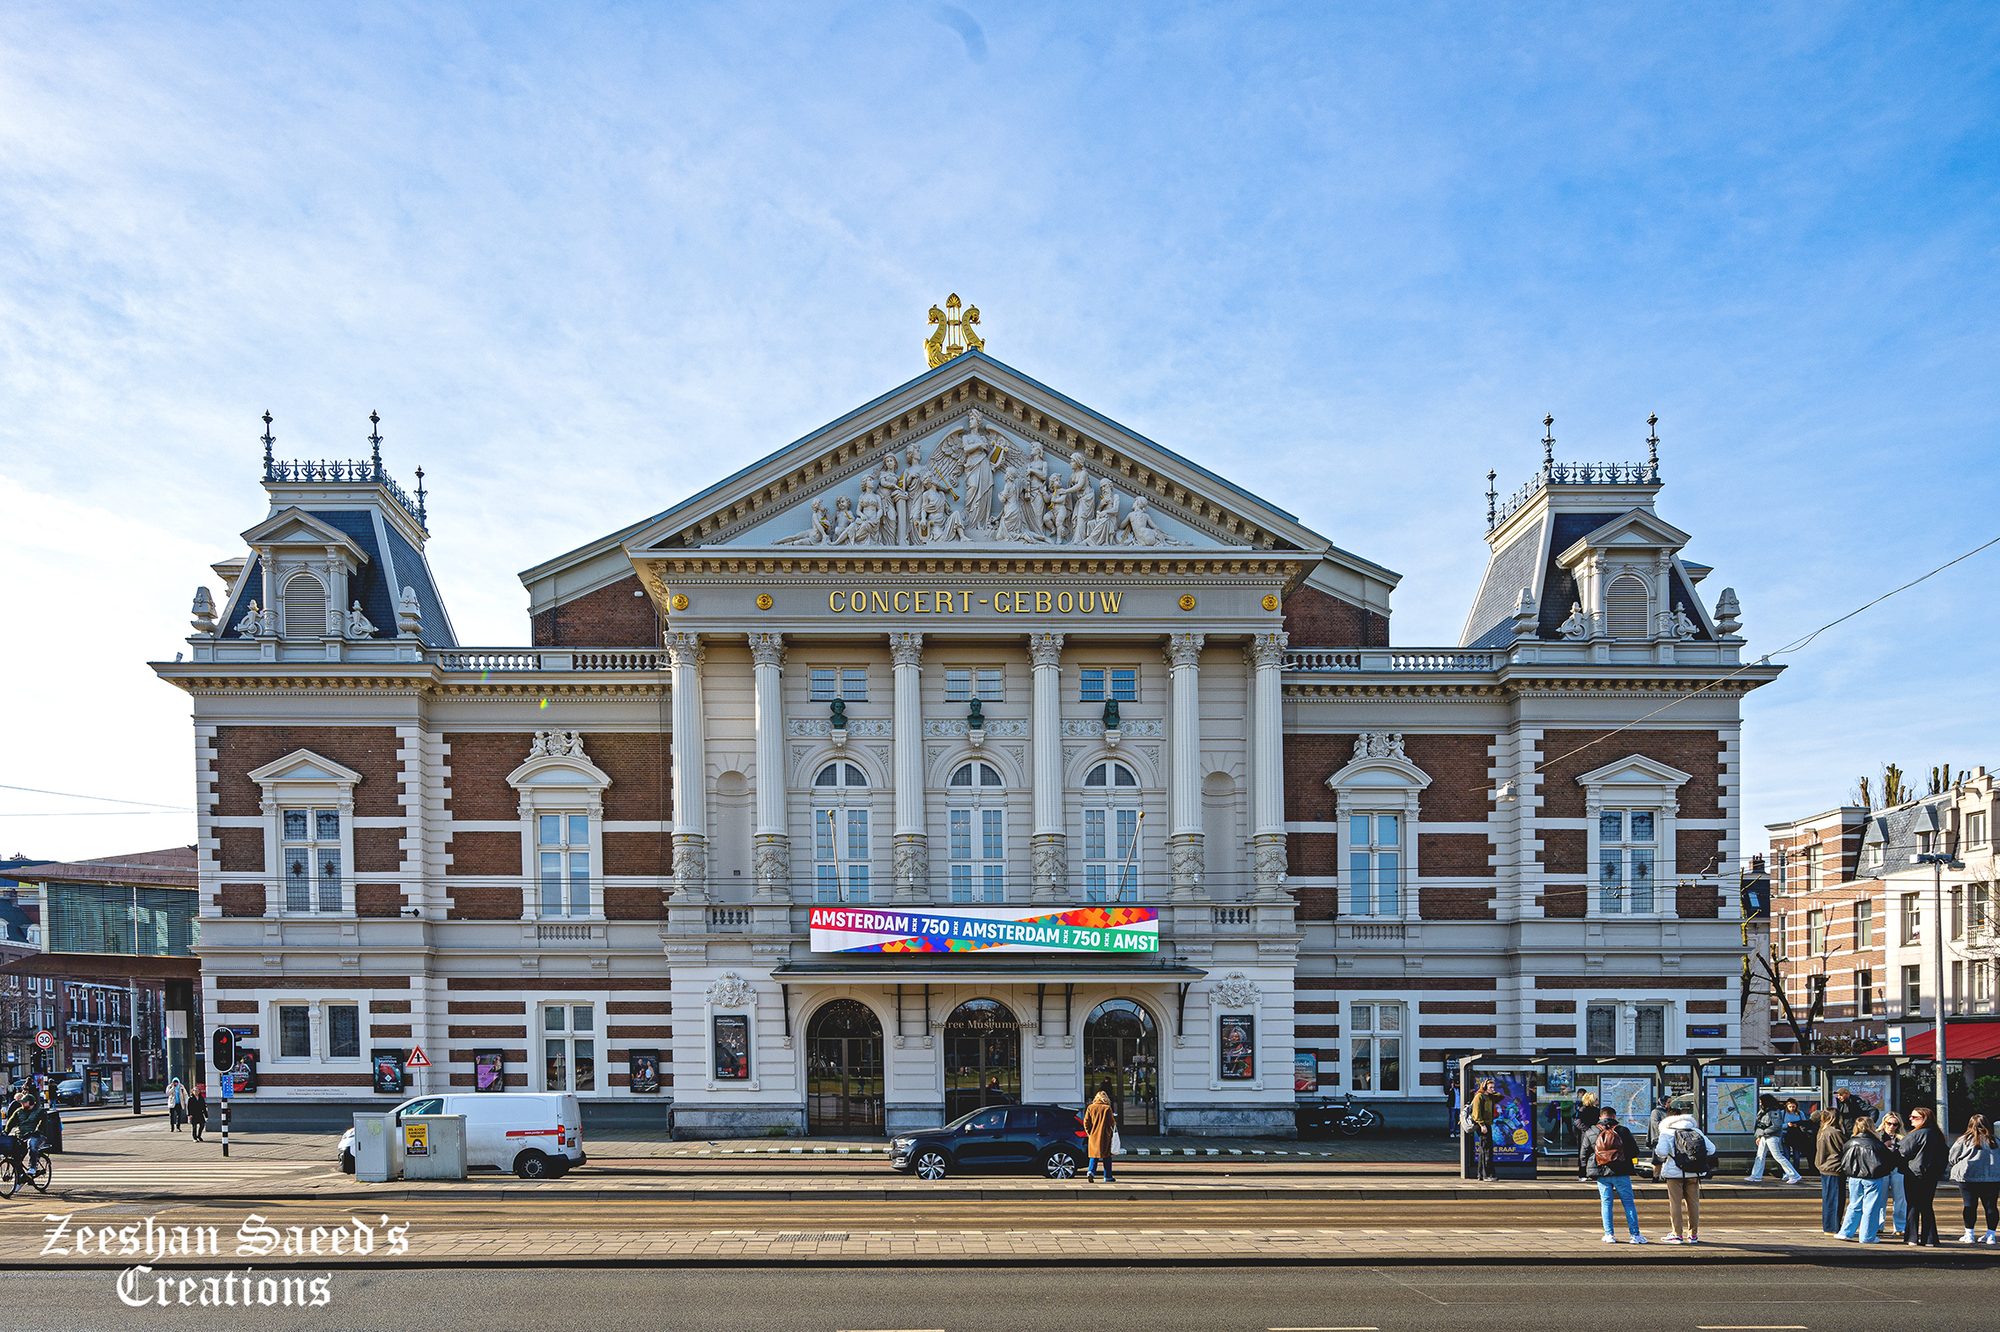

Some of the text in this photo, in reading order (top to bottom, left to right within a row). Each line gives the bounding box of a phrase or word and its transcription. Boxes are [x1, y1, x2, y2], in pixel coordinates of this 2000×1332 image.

[829, 590, 1125, 613] CONCERT-GEBOUW
[811, 909, 909, 933] AMSTERDAM
[921, 918, 950, 936] 750
[962, 921, 1060, 944] AMSTERDAM
[1072, 929, 1101, 947] 750
[1113, 933, 1158, 951] AMST
